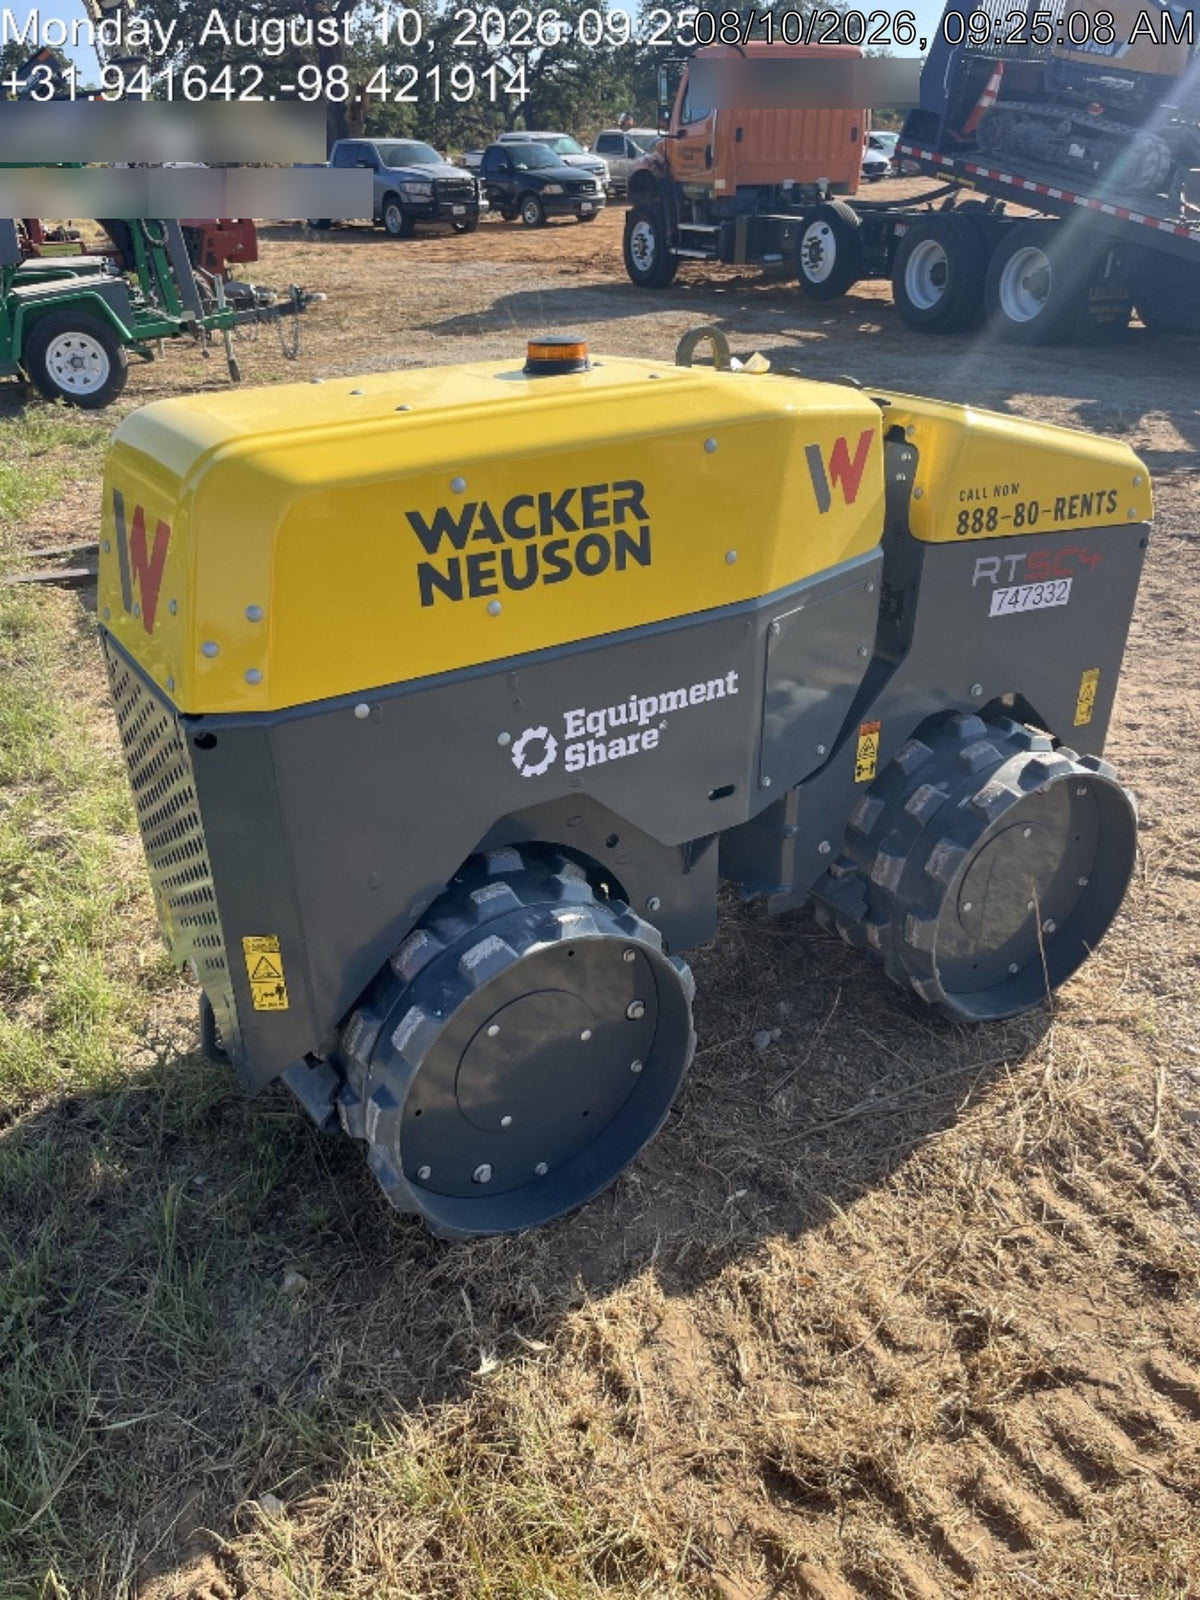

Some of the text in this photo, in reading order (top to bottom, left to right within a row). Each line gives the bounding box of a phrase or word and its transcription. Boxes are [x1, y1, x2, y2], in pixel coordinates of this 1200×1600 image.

[405, 479, 650, 556] WACKER
[956, 488, 1119, 536] 888-80-RENTS
[959, 482, 1020, 502] CALL NOW
[417, 525, 653, 608] NEUSON
[996, 580, 1070, 612] 747332
[563, 669, 740, 741] Equipment
